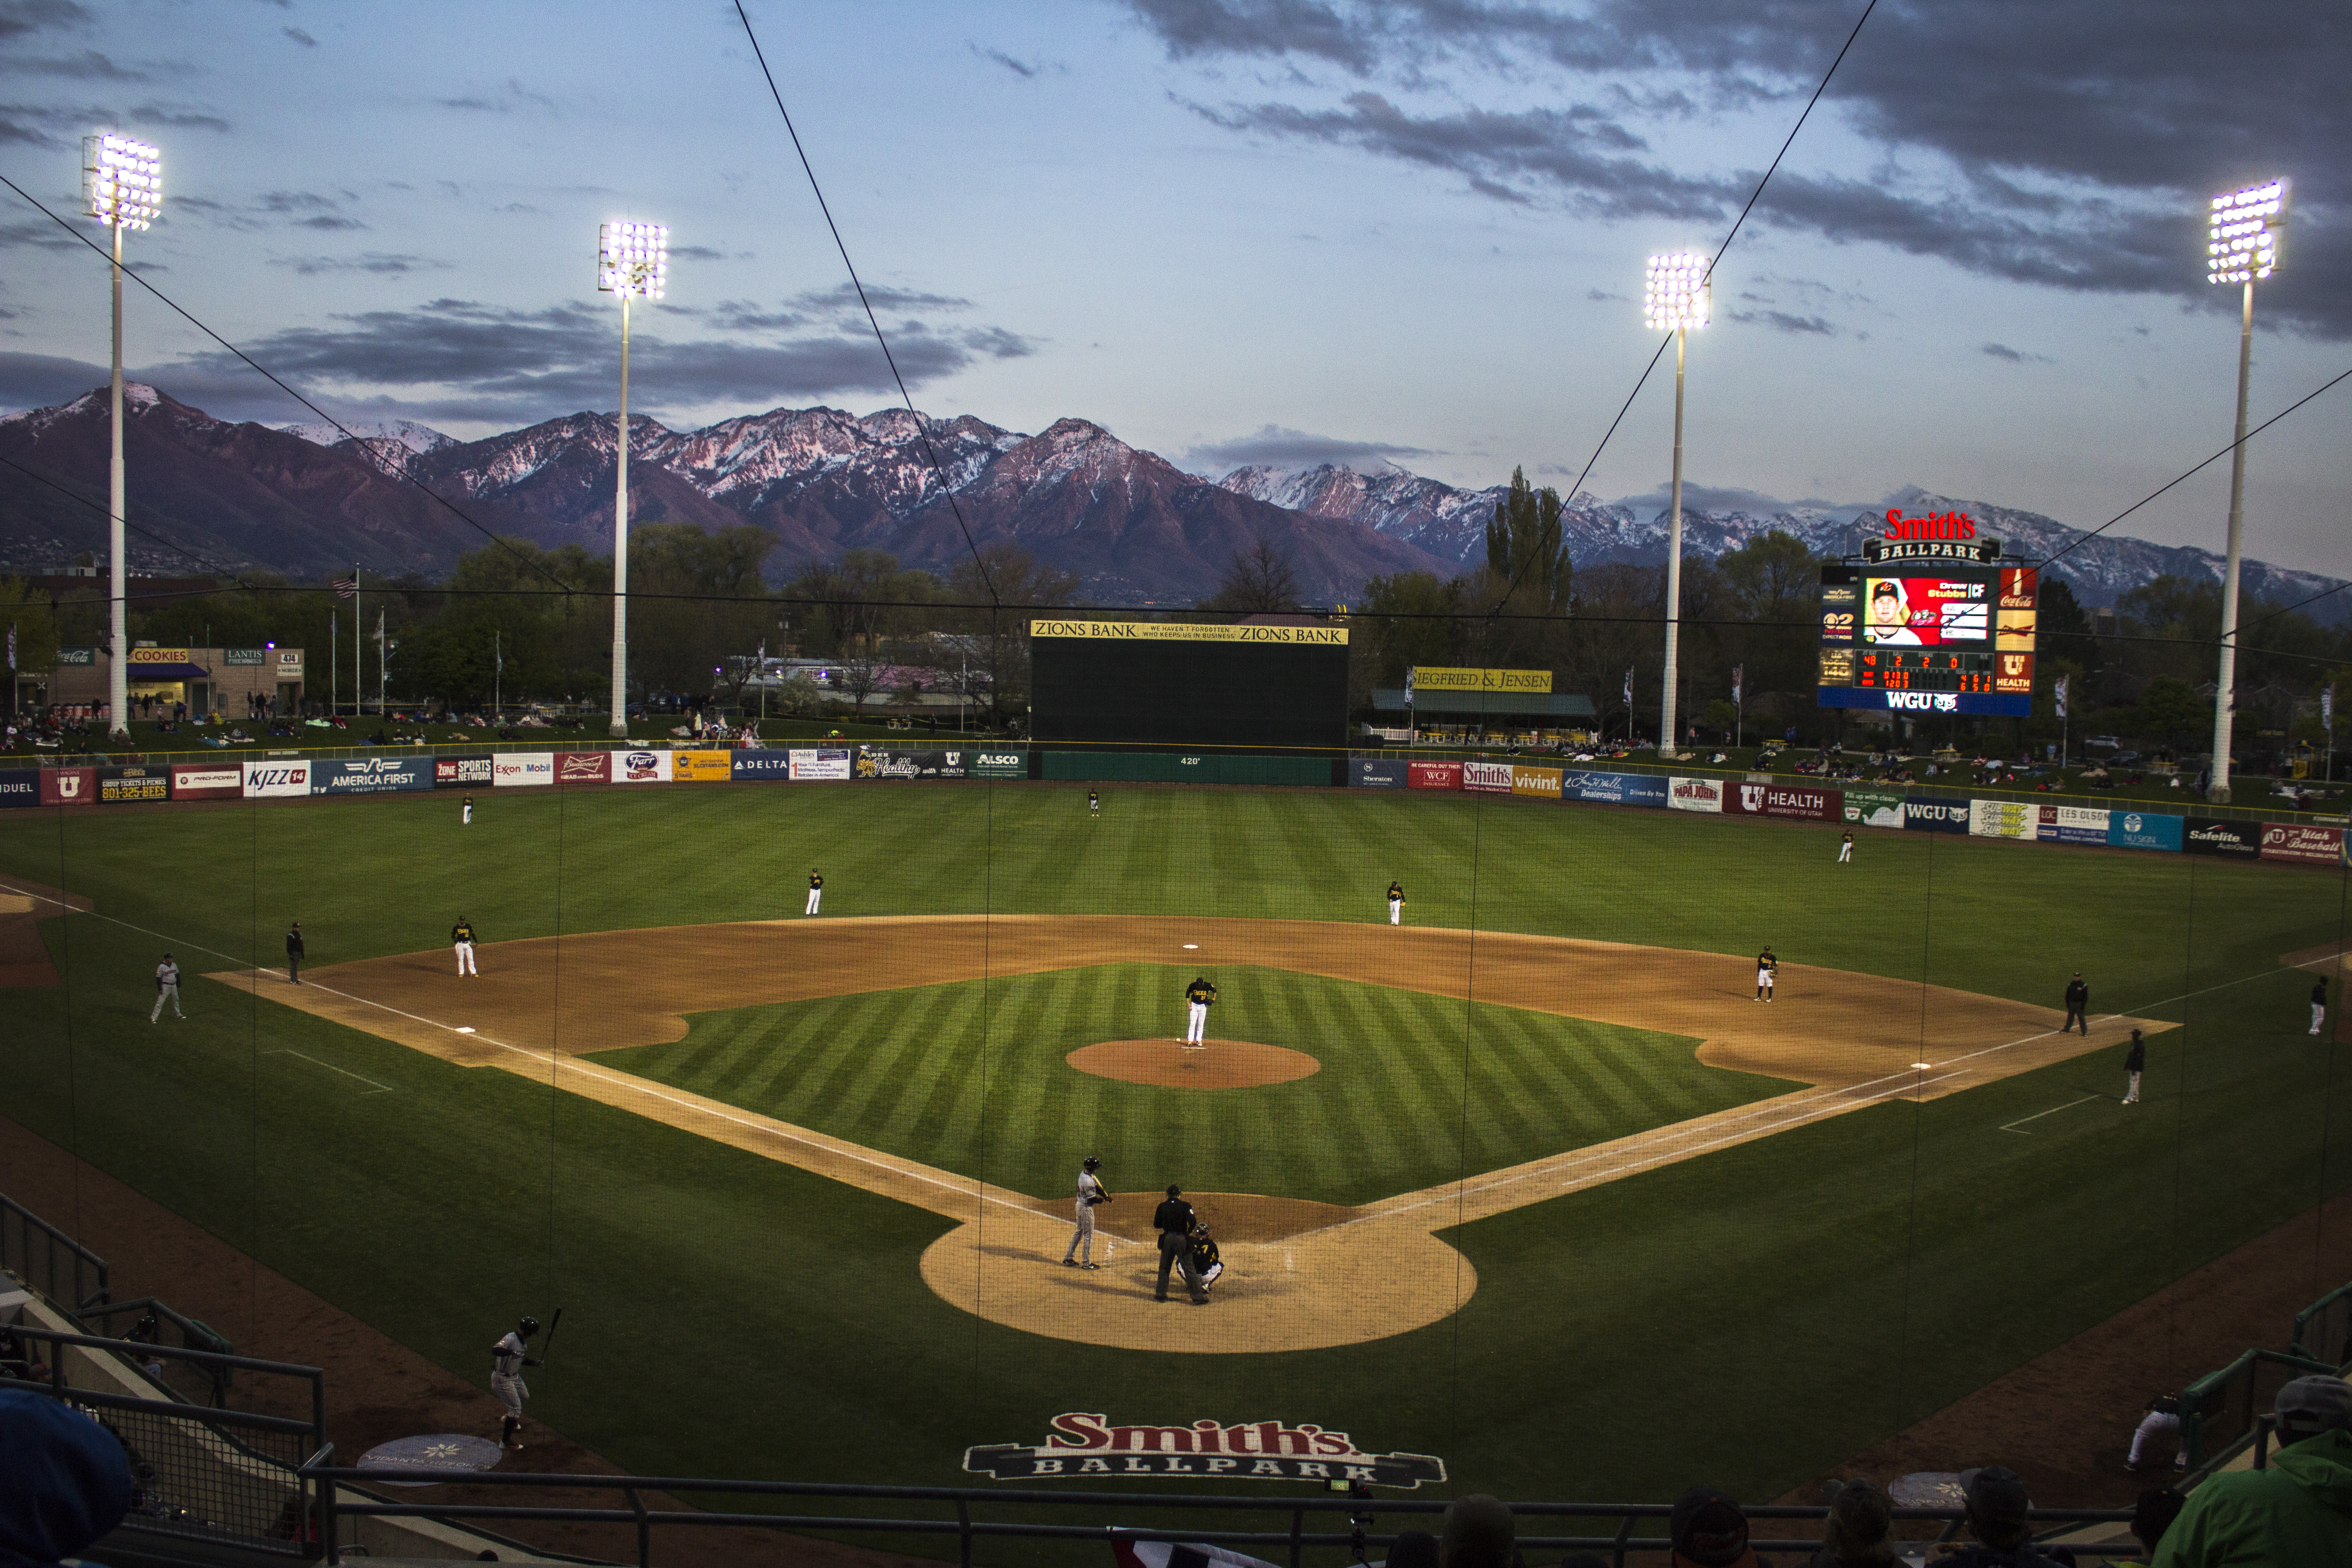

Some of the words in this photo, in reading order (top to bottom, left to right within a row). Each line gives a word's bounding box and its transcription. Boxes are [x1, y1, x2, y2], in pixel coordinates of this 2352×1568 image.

[1886, 508, 1975, 539] Smith's
[1880, 544, 1980, 560] BALLPARK
[1928, 589, 1967, 598] Stubbs
[1838, 613, 1854, 630] 2
[1035, 622, 1086, 636] ZIONS
[1091, 624, 1137, 637] BANK
[1240, 627, 1290, 641] ZIONS
[1296, 629, 1342, 642] BANK
[135, 651, 186, 661] COOKIES
[1864, 655, 1876, 666] 48
[1895, 656, 1901, 667] 2
[1923, 657, 1930, 668] 2
[1950, 658, 1957, 668] 0
[1413, 670, 1478, 686] SIEGFRIED
[1482, 673, 1494, 686] &
[1499, 672, 1550, 688] JENSEN
[1996, 678, 2030, 687] HEALTH
[1984, 683, 1990, 692] 0
[1886, 691, 1931, 709] WGU
[629, 754, 655, 769] Farr
[747, 760, 787, 769] DELTA
[976, 754, 1019, 764] ALSCO
[458, 760, 491, 772] SPORTS
[496, 765, 521, 775] Exxon
[791, 762, 797, 777] 1
[874, 757, 921, 779] Healthy
[248, 769, 290, 790] KJZZ
[292, 772, 303, 781] 14
[331, 775, 382, 787] AMERICA
[383, 773, 415, 784] FIRST
[458, 771, 491, 781] NETWORK
[1426, 771, 1448, 780] WCF
[1465, 764, 1510, 784] Smith's
[57, 776, 80, 797] U
[1515, 774, 1559, 790] vivint.
[0, 784, 33, 793] DUEL
[102, 786, 166, 799] 801-325-BEES
[1675, 785, 1693, 797] PAPA
[1581, 789, 1622, 801] Dealerships
[1769, 792, 1824, 808] HEALTH
[1906, 803, 1947, 820] WGU
[1981, 802, 2027, 814] SUBWAY
[1980, 813, 2027, 825] SUBWAY
[2041, 810, 2056, 819] LOC
[2062, 809, 2077, 818] LES
[2080, 811, 2110, 821] OLSON
[1980, 824, 2026, 837] SUBWAY
[2189, 830, 2240, 843] Safelite
[2301, 829, 2330, 840] Utah
[2217, 843, 2254, 852] AutoGlass
[2287, 838, 2340, 851] Baseball
[1047, 1412, 1361, 1457] Smith's
[1033, 1456, 1377, 1482] BALLPARK
